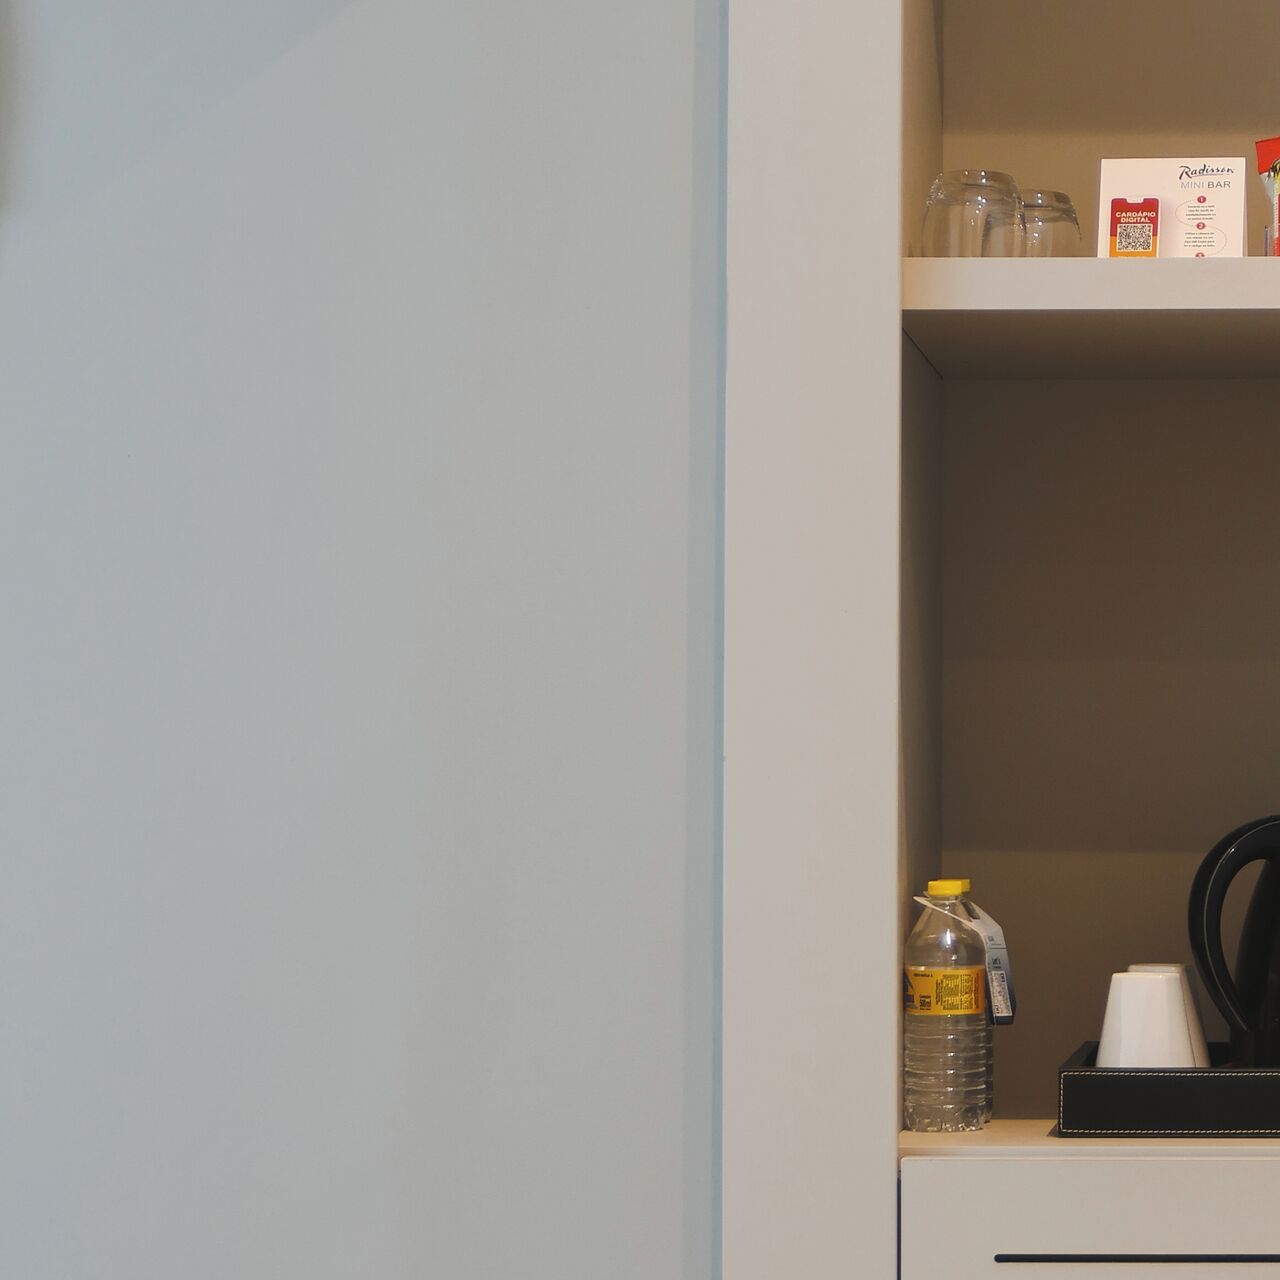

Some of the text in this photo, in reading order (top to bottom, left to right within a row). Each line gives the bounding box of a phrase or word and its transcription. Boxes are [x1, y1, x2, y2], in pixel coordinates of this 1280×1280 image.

[1178, 163, 1235, 180] Radisson
[1181, 180, 1231, 189] MINI BAR
[1116, 210, 1156, 218] CARDÁPIO
